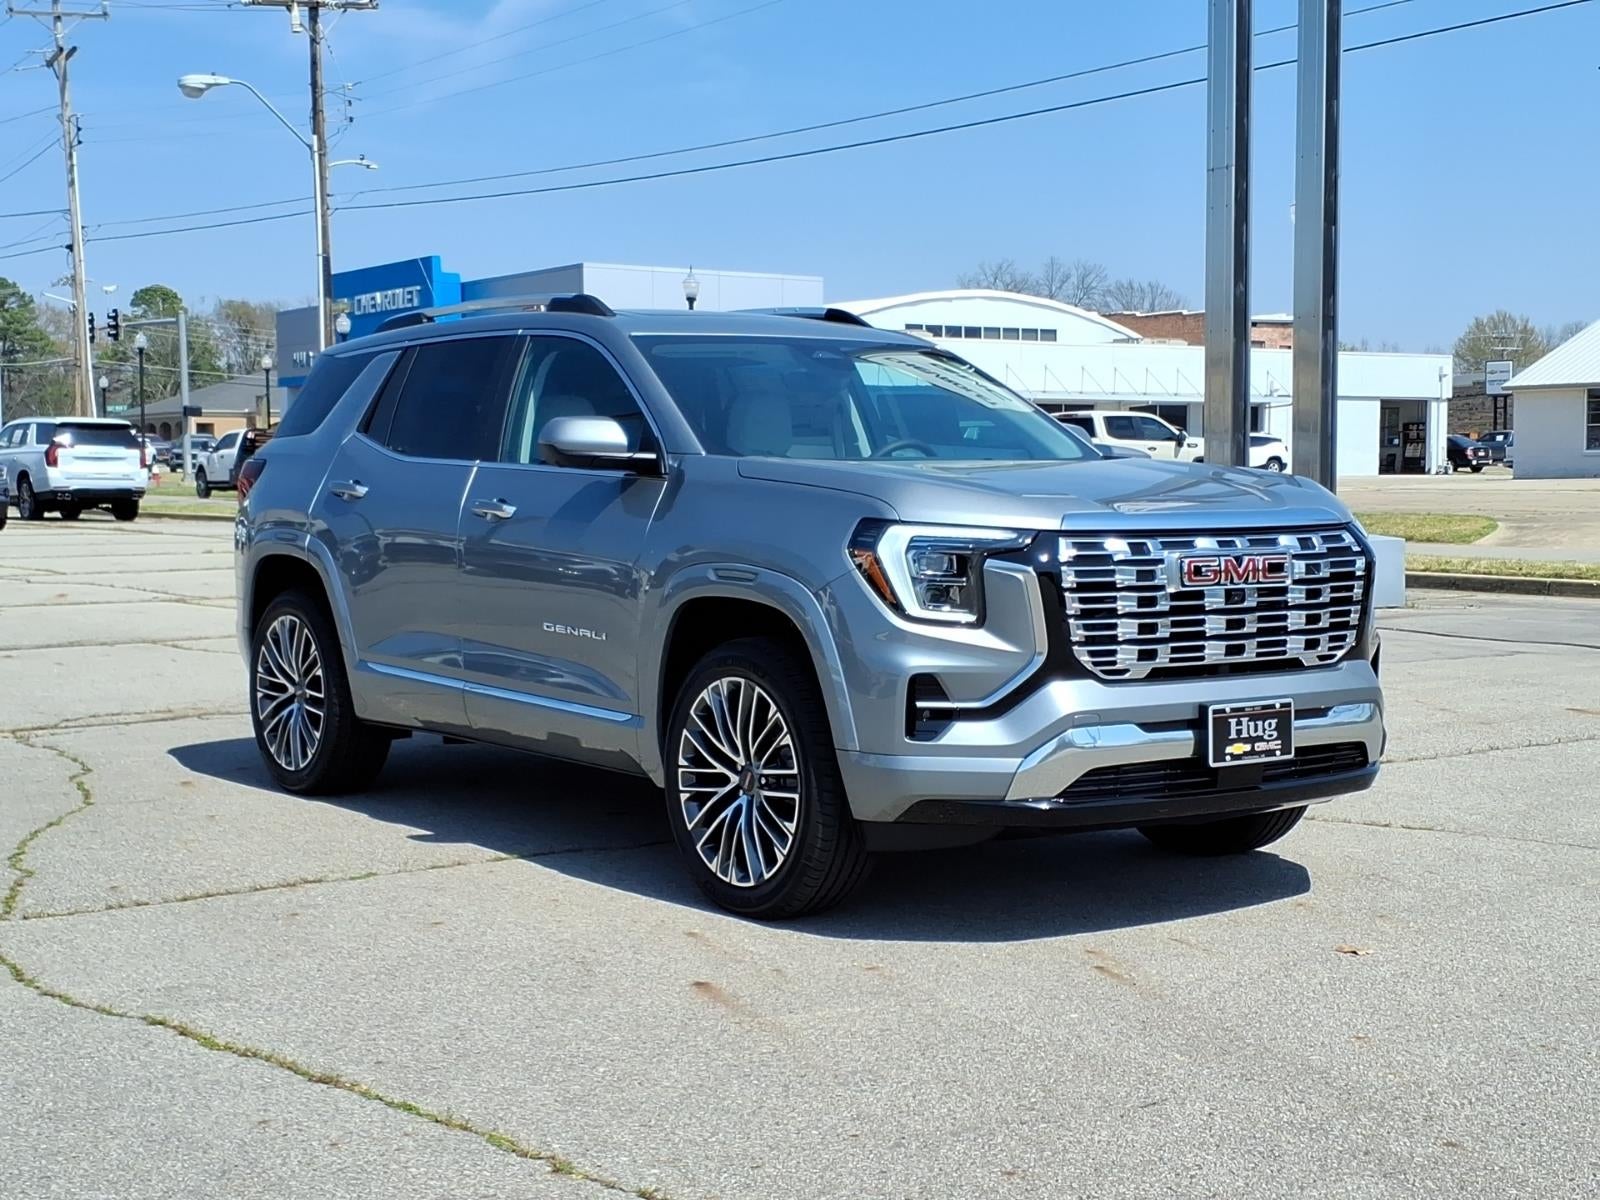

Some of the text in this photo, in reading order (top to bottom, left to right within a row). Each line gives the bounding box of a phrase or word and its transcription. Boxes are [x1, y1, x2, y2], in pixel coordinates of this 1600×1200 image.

[354, 285, 421, 315] CHEVROLET
[1182, 554, 1289, 586] GMC
[543, 622, 606, 640] DENALI
[1228, 717, 1279, 740] Hug
